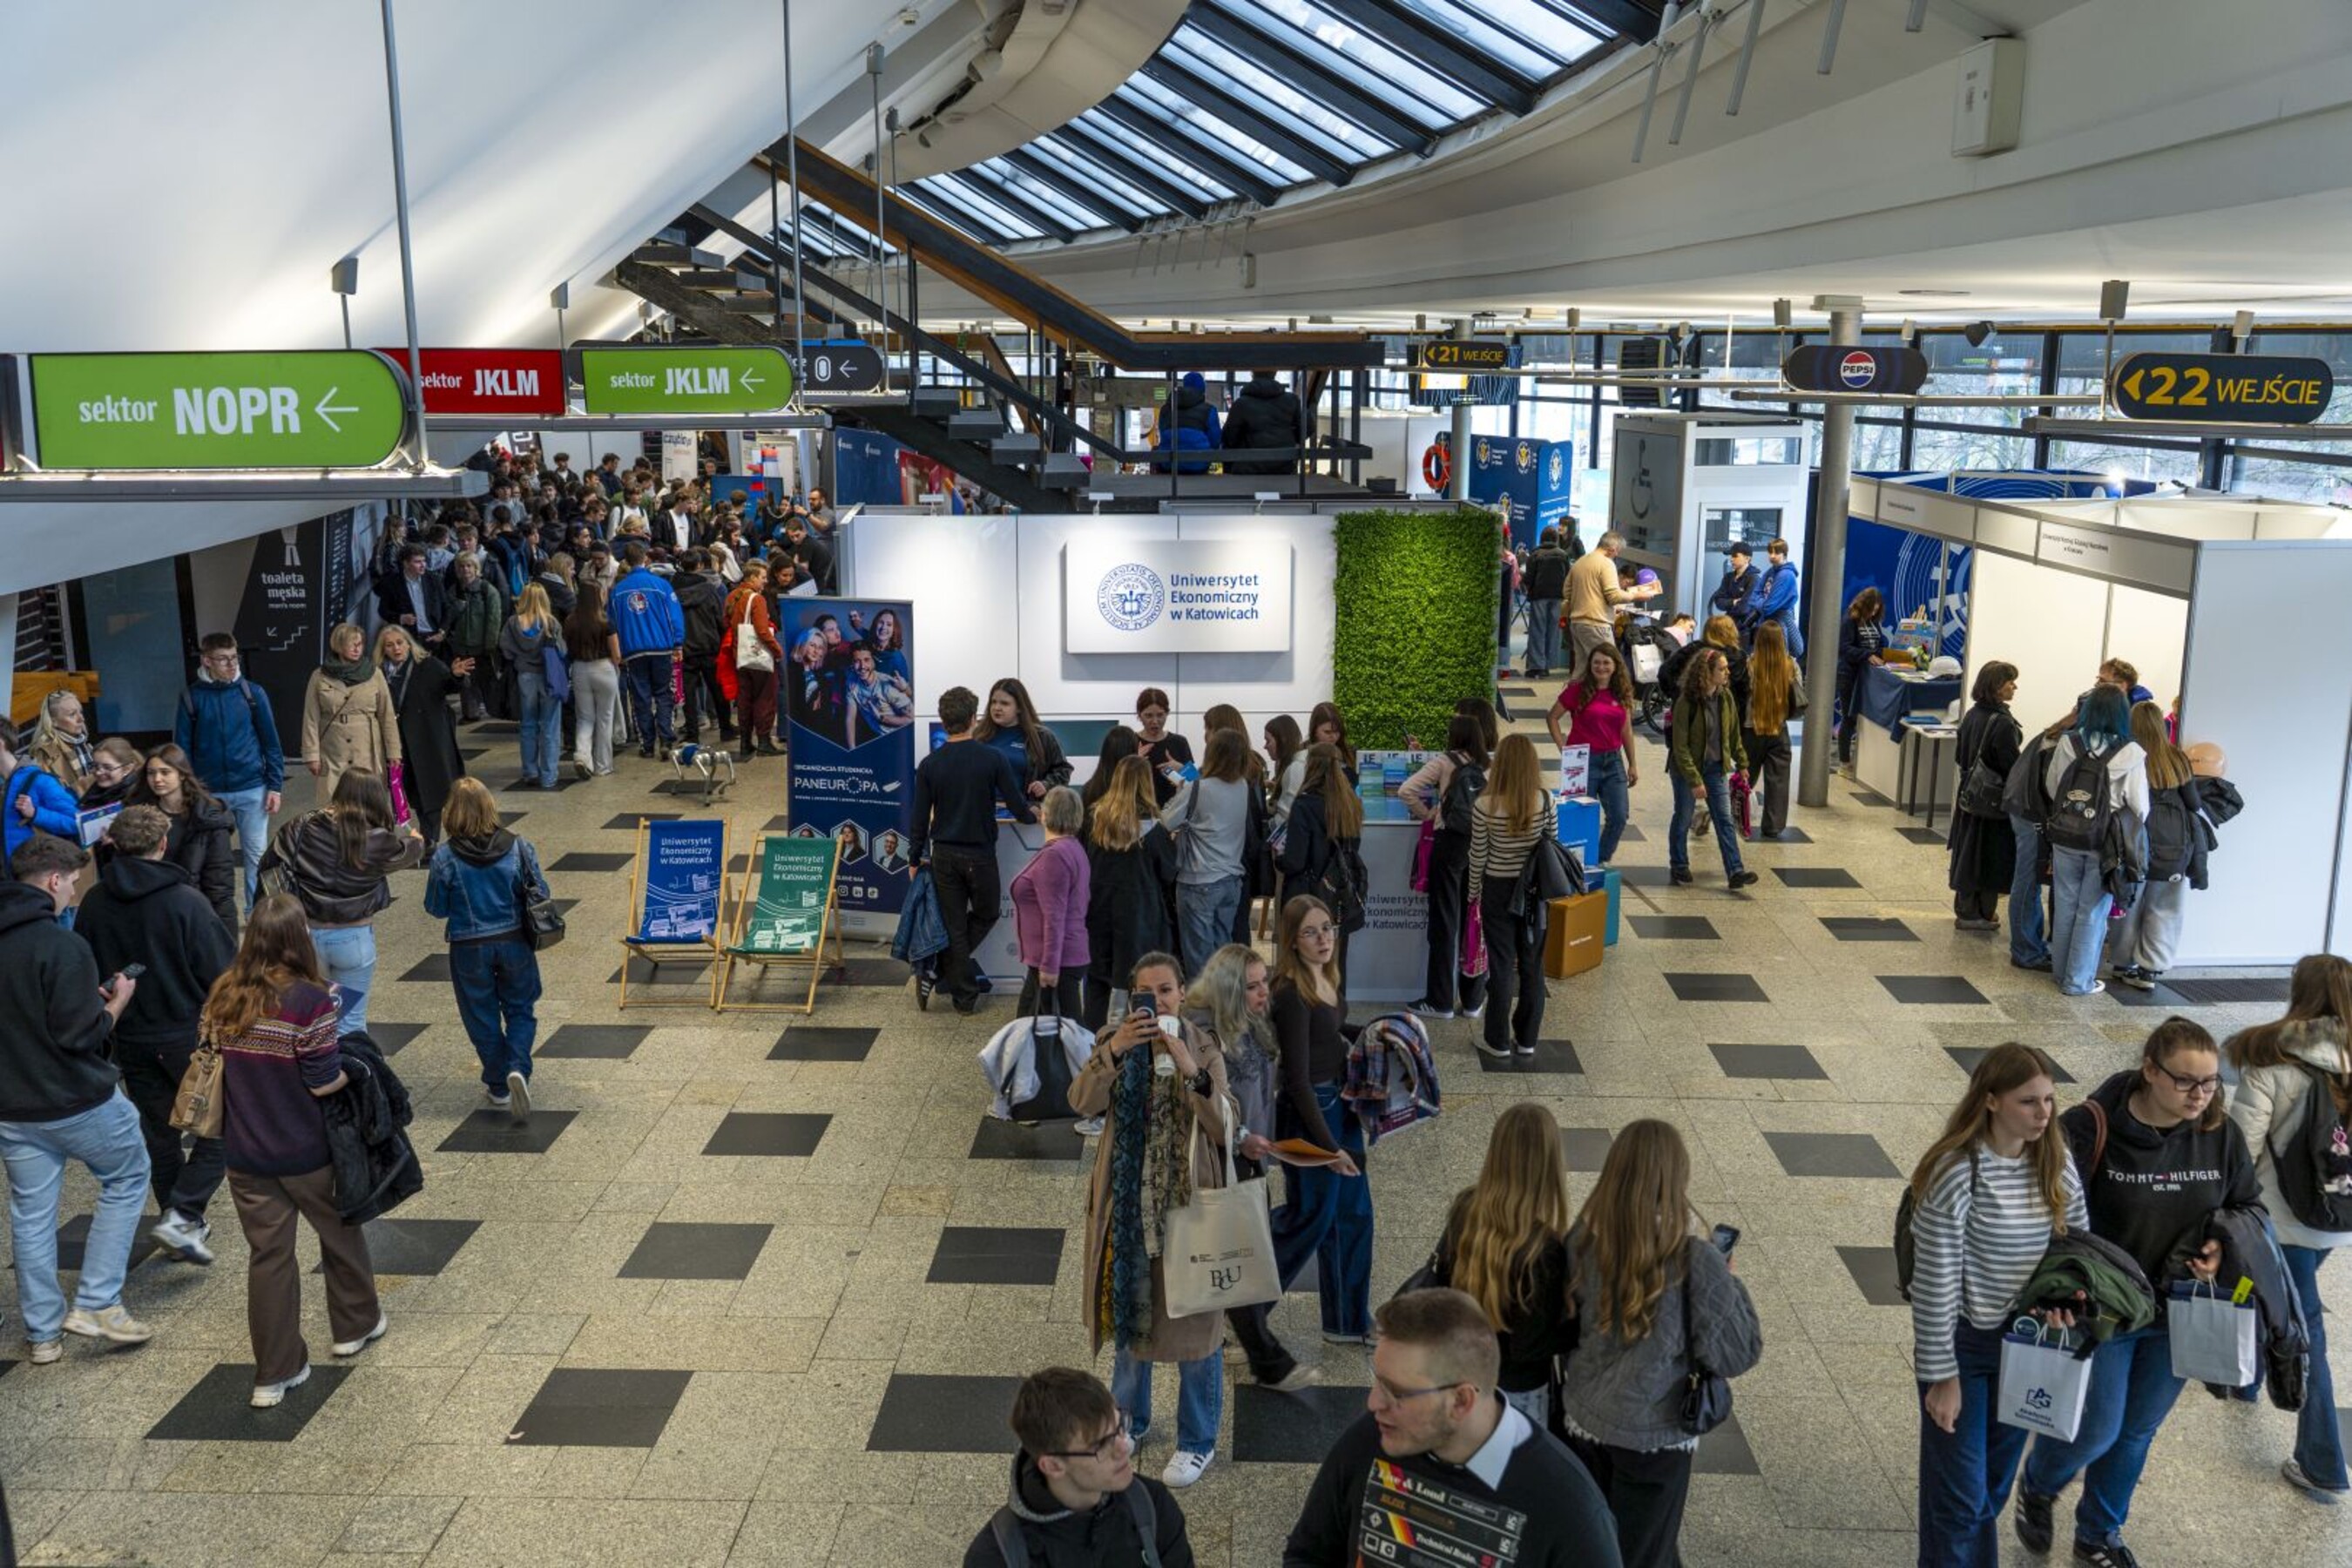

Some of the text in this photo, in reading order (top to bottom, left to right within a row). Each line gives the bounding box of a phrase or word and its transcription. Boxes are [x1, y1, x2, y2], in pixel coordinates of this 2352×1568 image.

[1438, 346, 1504, 362] 21 WEJŚCIE
[1843, 364, 1873, 374] PEPSI
[420, 369, 539, 395] sektor JKLM
[610, 367, 730, 395] sektor JKLM
[2146, 366, 2322, 406] 22 WEJŚCIE
[78, 387, 301, 436] sektor NOPR
[261, 571, 304, 585] toaleta
[1171, 573, 1259, 589] Uniwersytet
[268, 585, 306, 601] męska
[1171, 590, 1259, 605] Ekonomiczny
[1170, 606, 1259, 620] w Katowicach
[661, 837, 712, 847] Uniwersytet
[660, 846, 713, 855] Ekonomiczny
[774, 854, 824, 864] Uniwersytet
[774, 862, 824, 873] Ekonomiczny
[2106, 1169, 2221, 1183] TOMMY HILFIGER
